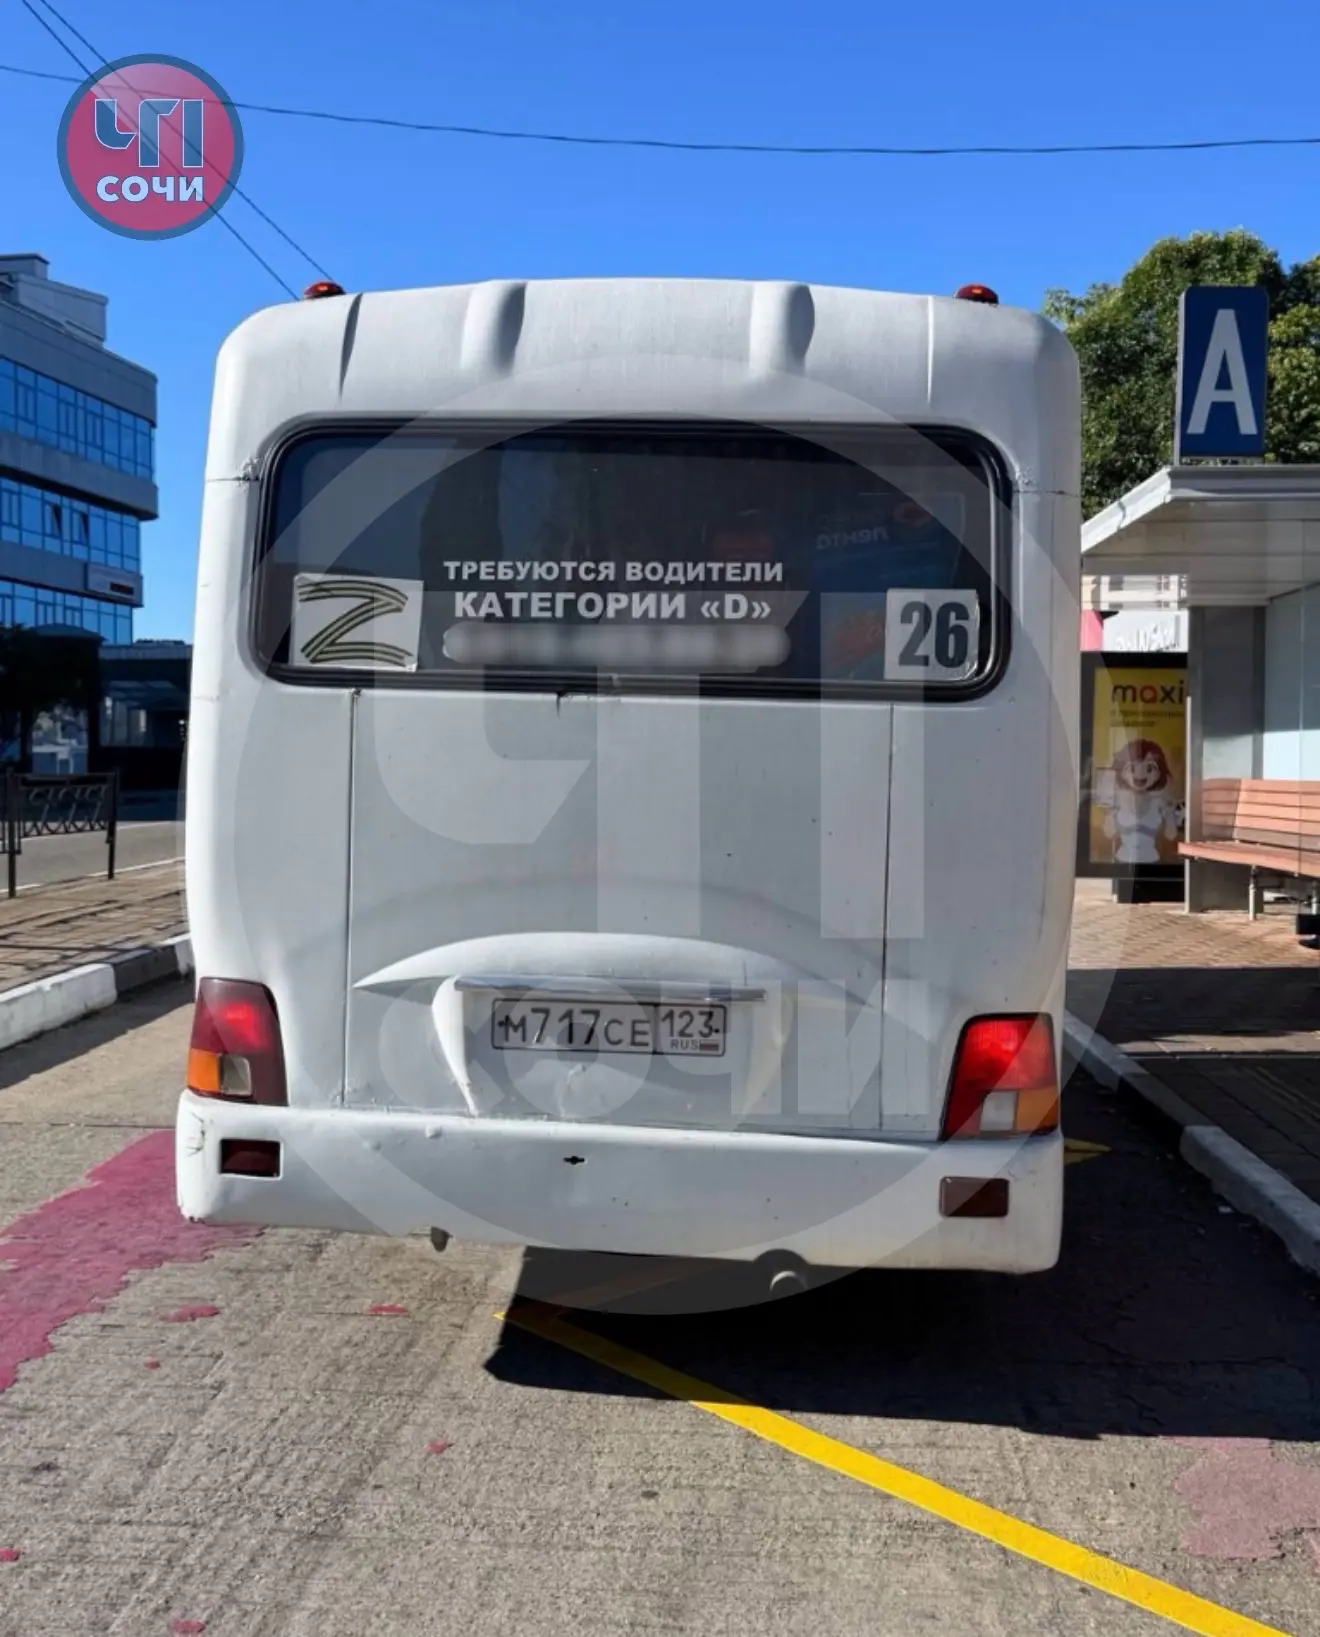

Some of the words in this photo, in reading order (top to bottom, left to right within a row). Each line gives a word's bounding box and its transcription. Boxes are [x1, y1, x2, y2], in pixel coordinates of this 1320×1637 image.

[1186, 309, 1258, 434] А
[443, 561, 615, 581] ТРЕБУЮТСЯ
[625, 561, 783, 584] ВОДИТЕЛИ
[454, 592, 686, 619] КАТЕГОРИИ
[700, 593, 771, 619] «D»
[297, 580, 415, 667] Z
[898, 601, 970, 669] 26
[1111, 680, 1185, 704] maxi
[661, 1009, 716, 1039] 123
[671, 1038, 699, 1051] RUS
